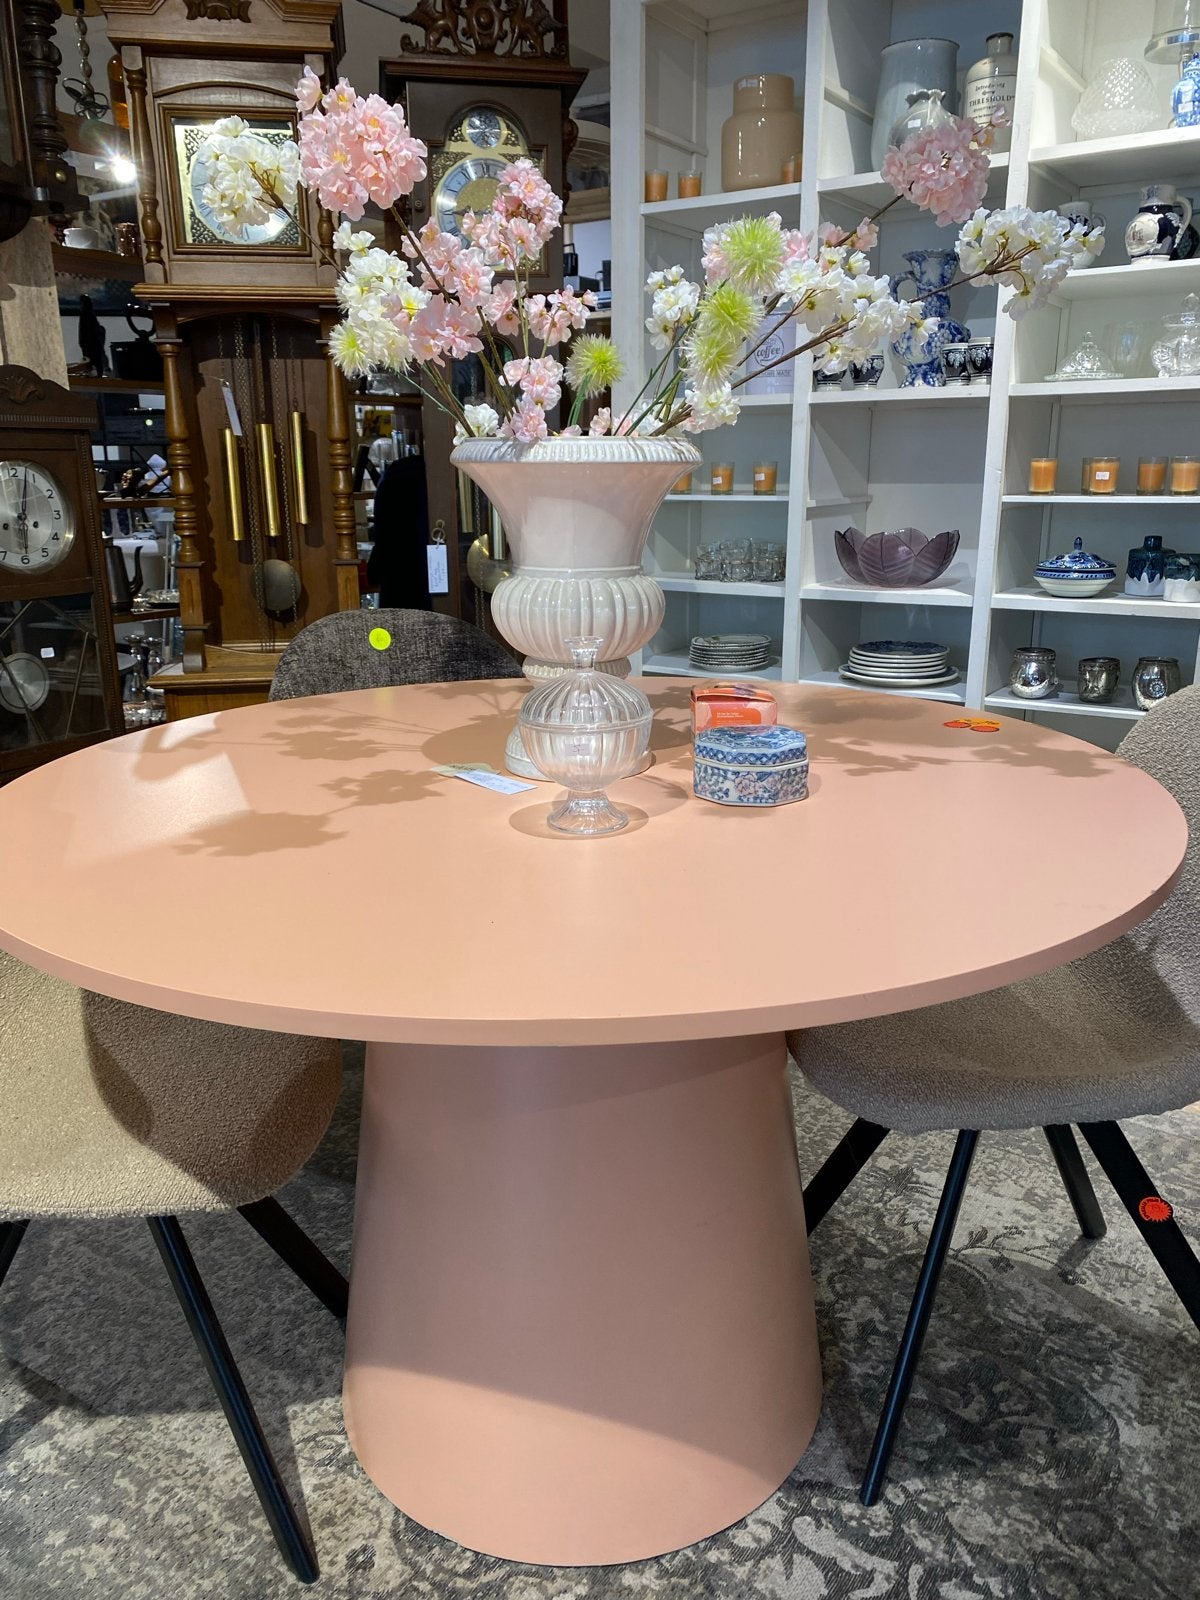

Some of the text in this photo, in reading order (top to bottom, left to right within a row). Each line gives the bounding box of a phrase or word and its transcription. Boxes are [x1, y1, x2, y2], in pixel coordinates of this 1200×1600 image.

[756, 346, 780, 358] coffee
[46, 489, 54, 499] 2
[53, 510, 61, 520] 3
[51, 532, 59, 541] 4
[41, 548, 49, 557] 5
[21, 555, 30, 564] 6
